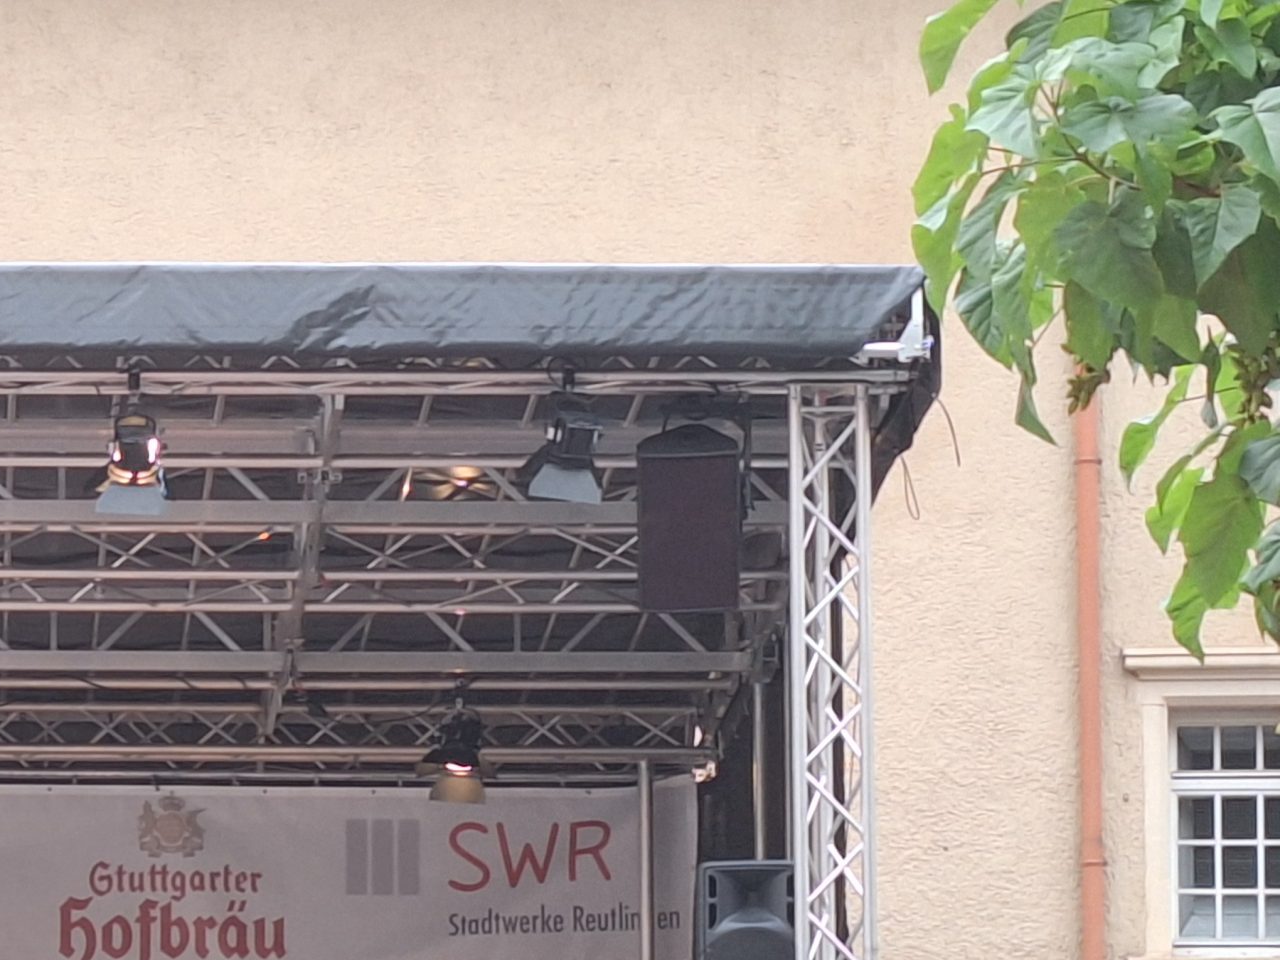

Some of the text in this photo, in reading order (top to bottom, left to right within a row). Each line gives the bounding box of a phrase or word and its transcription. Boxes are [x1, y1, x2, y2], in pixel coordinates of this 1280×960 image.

[447, 819, 613, 892] SWR
[88, 860, 264, 901] Stuttgarter
[448, 902, 681, 937] Stadtwerke Reutlinen
